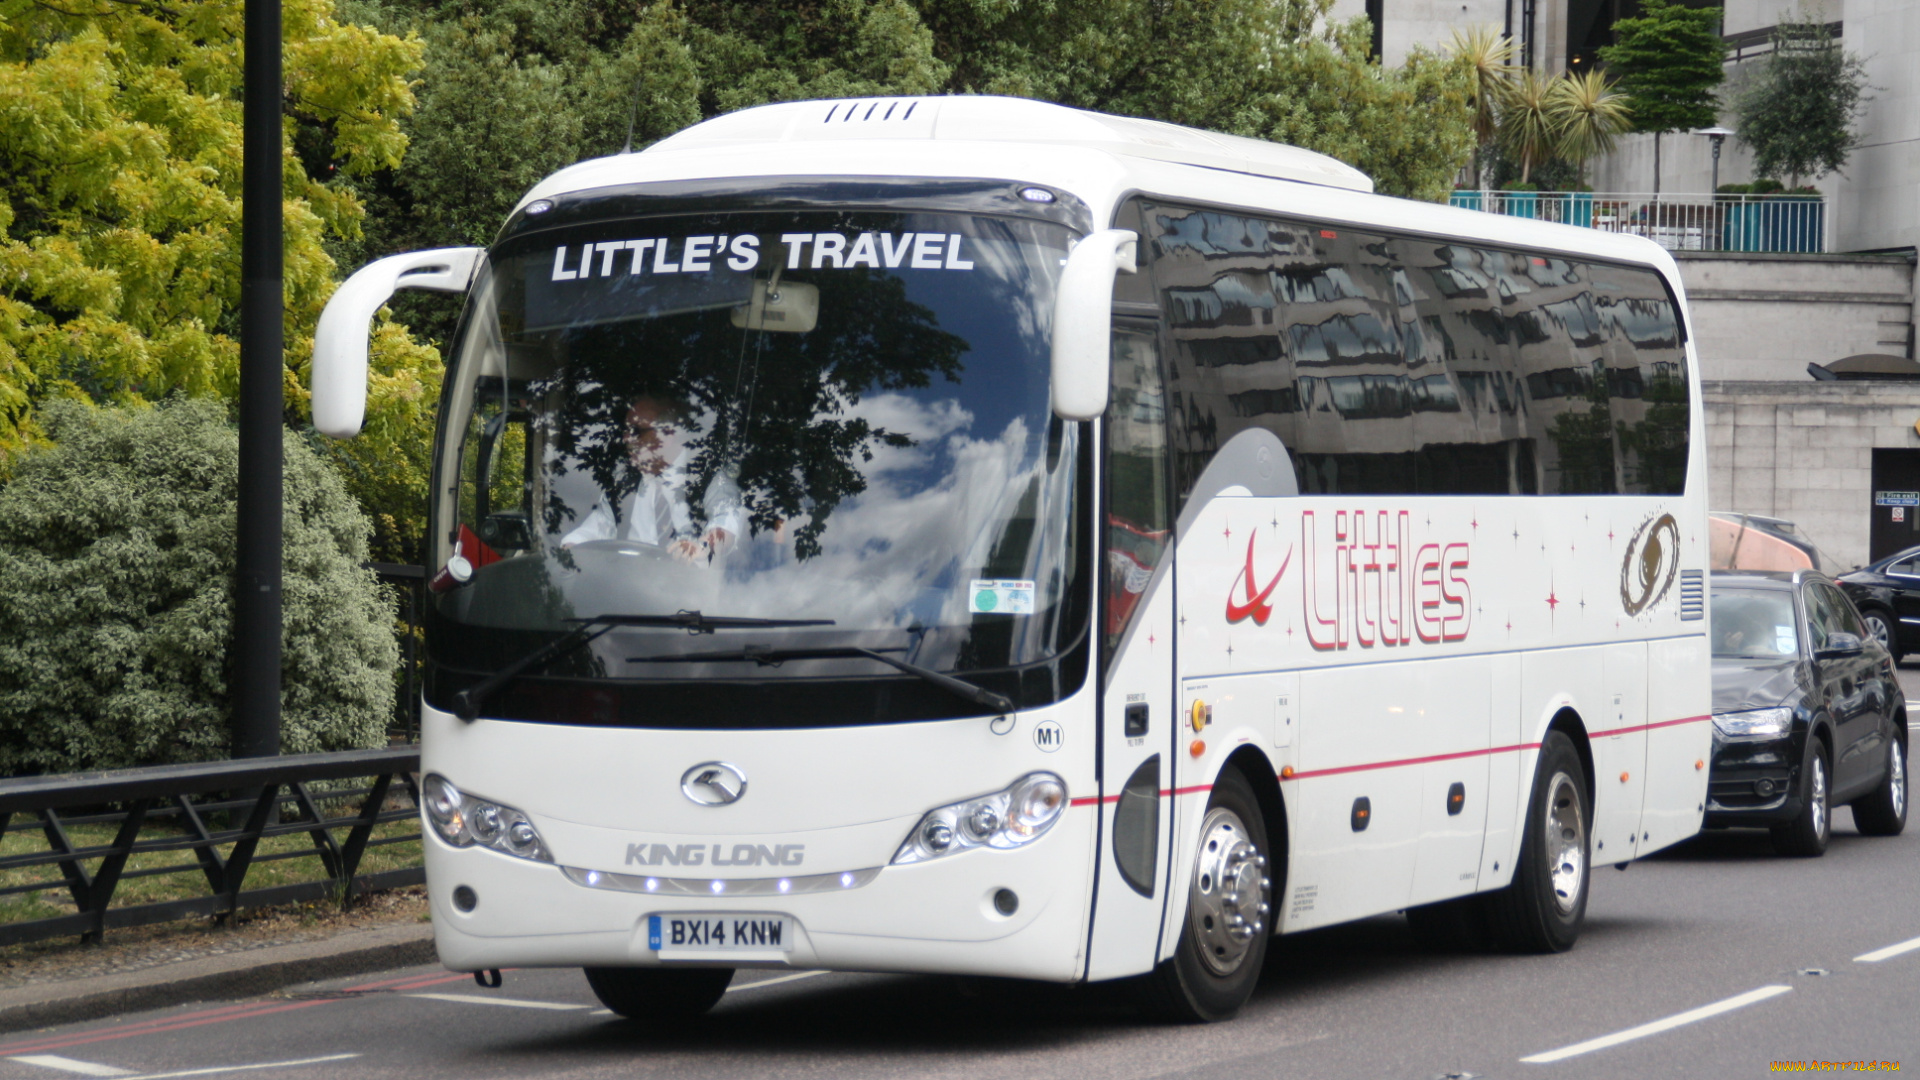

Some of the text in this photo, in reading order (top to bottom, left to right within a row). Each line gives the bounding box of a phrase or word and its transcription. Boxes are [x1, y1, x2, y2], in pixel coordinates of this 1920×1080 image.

[552, 232, 974, 281] LITTLE'S TRAVEL
[1302, 509, 1472, 652] Littles
[1037, 727, 1060, 745] M1
[625, 843, 805, 866] KING LONG
[670, 920, 782, 945] BX14 KNW
